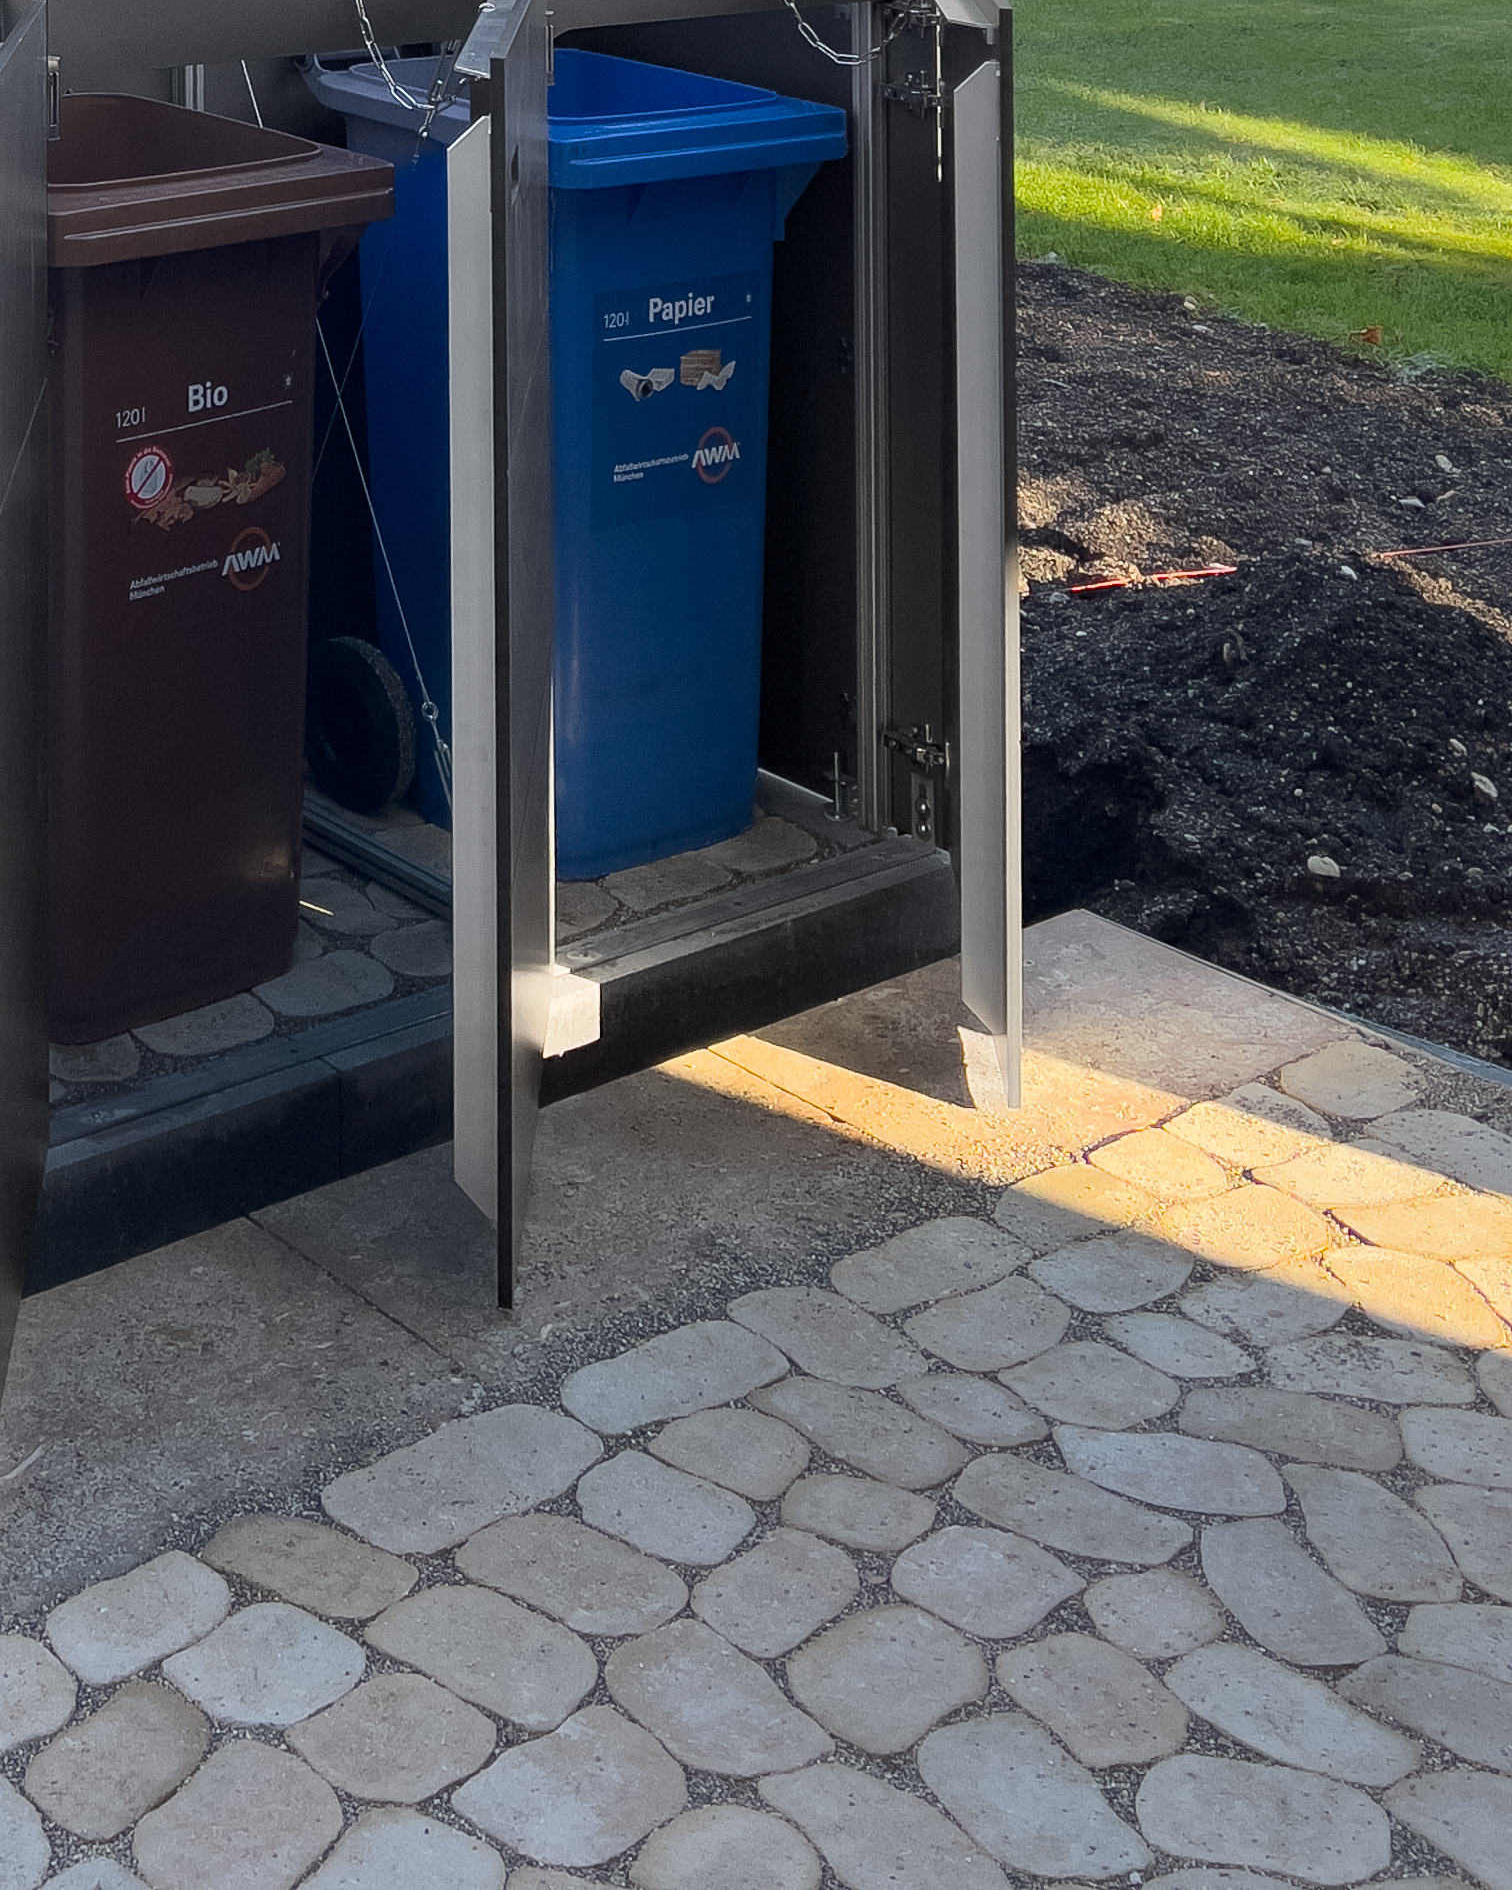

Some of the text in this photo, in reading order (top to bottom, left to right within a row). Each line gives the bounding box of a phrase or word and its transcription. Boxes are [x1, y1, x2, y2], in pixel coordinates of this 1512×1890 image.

[649, 293, 714, 324] Papier
[188, 381, 228, 412] Bio
[692, 443, 739, 468] AWM
[222, 543, 281, 576] AWM
